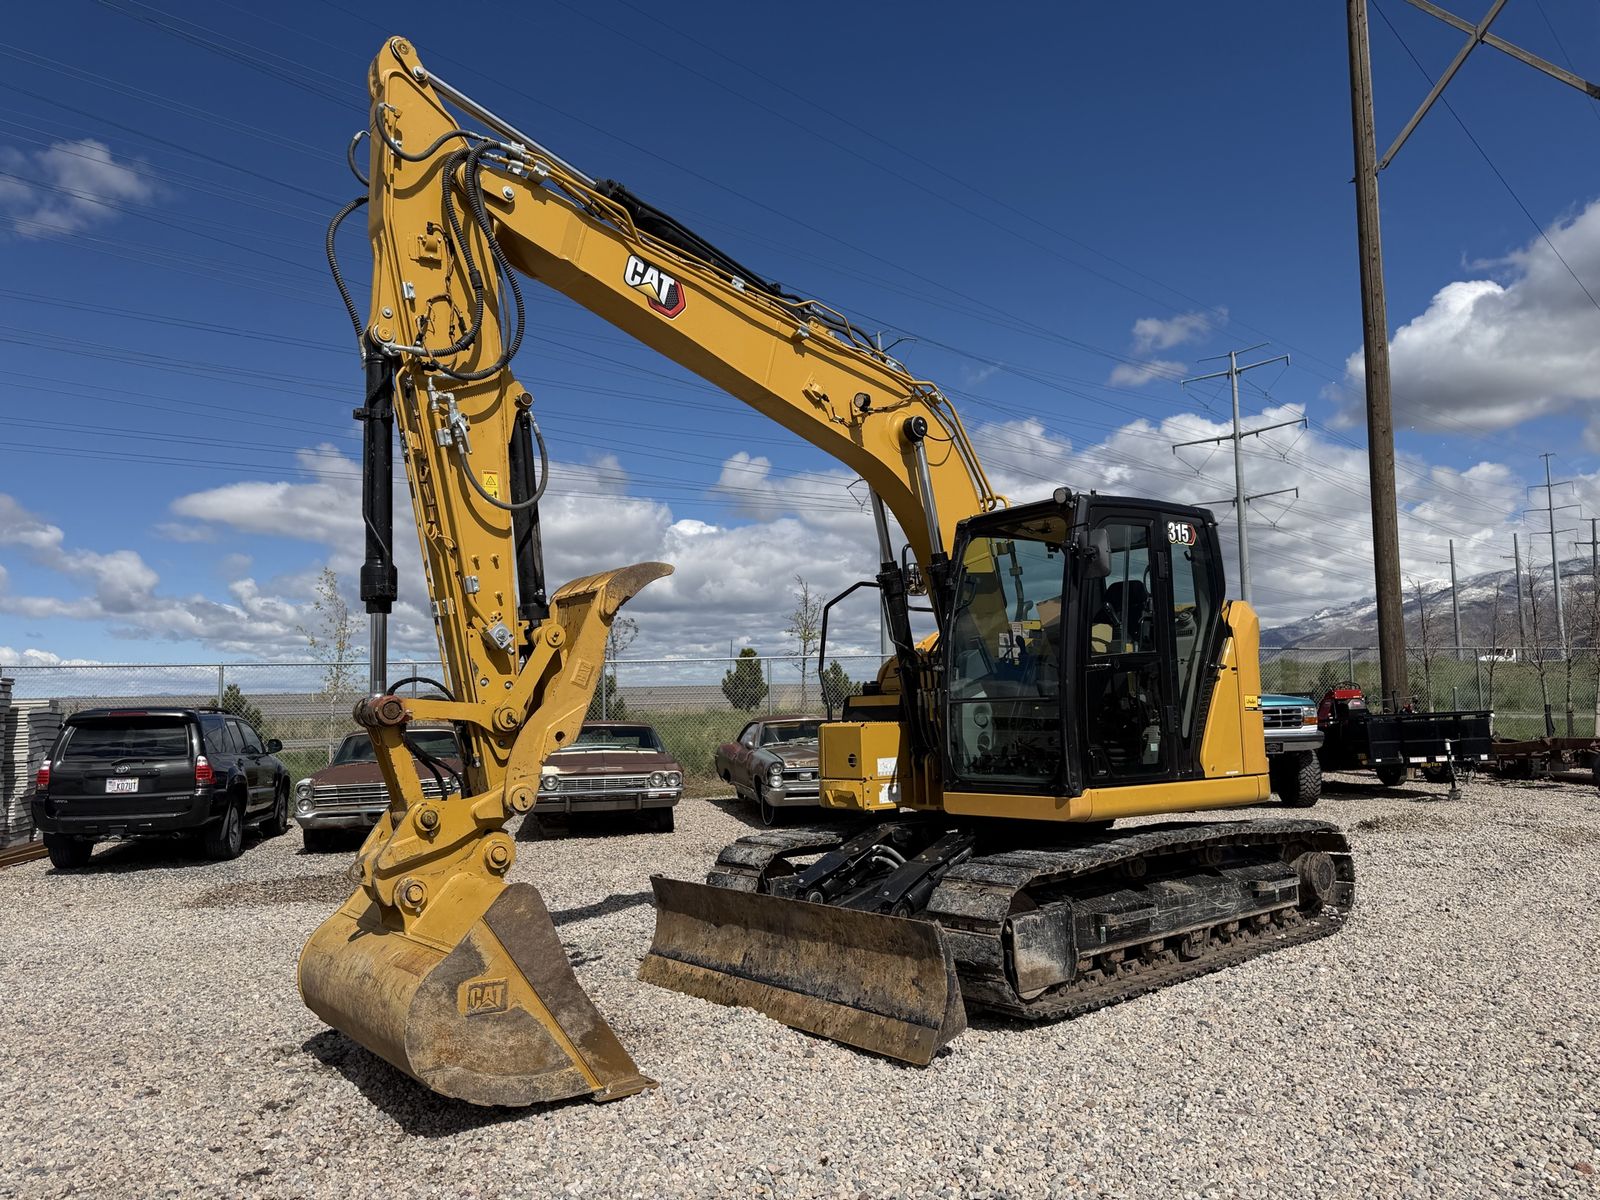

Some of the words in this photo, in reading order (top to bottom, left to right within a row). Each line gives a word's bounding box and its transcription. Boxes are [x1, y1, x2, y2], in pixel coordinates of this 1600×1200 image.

[624, 255, 676, 305] CAT
[1168, 521, 1189, 543] 315
[469, 984, 505, 1009] CAT
